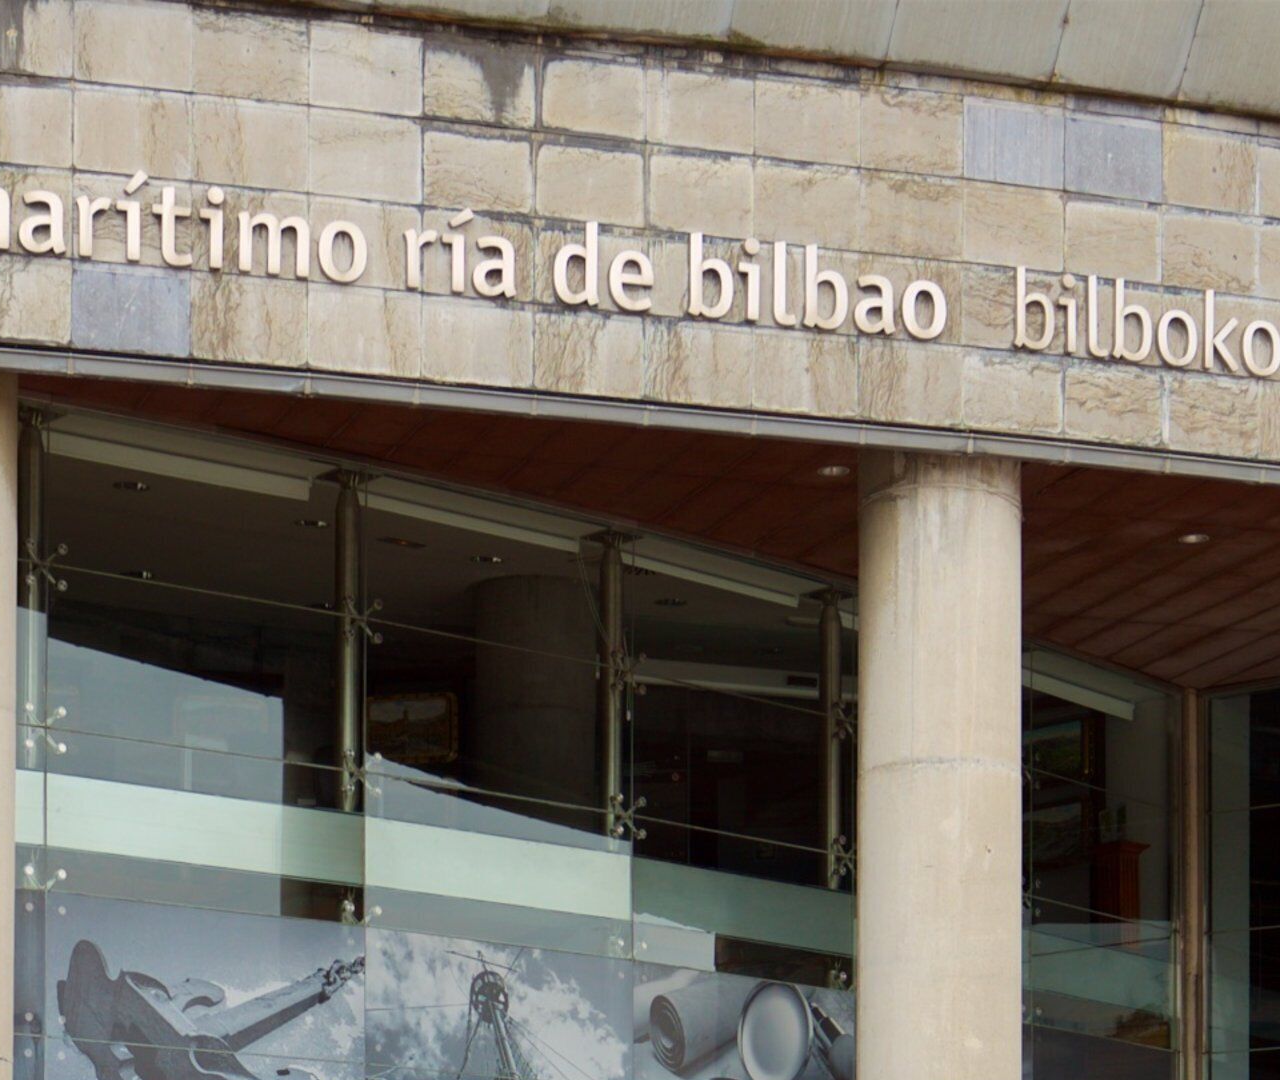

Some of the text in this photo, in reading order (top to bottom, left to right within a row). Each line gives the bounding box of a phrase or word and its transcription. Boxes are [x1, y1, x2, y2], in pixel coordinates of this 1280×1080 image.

[403, 208, 517, 300] ría
[552, 221, 654, 313] de
[687, 232, 947, 340] bilbao
